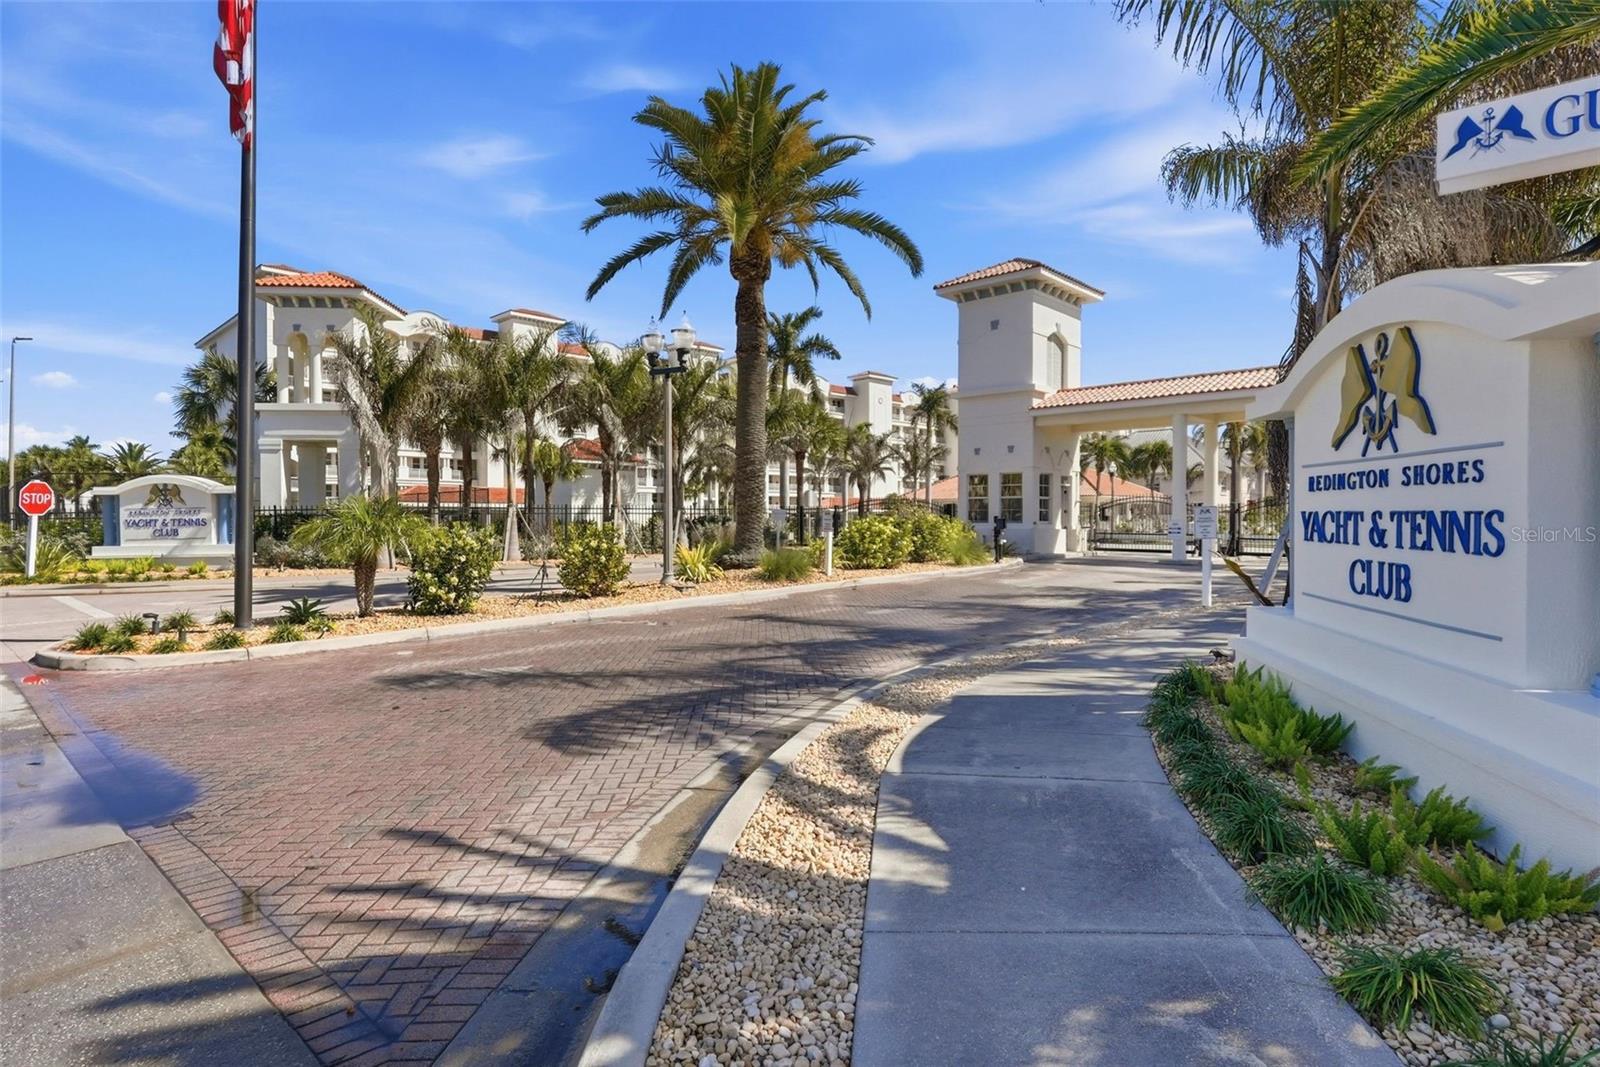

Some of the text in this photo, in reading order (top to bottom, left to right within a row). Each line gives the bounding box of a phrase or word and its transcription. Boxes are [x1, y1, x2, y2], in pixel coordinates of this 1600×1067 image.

[1308, 459, 1485, 492] REDINGTON SHORES
[22, 492, 51, 505] STOP
[125, 518, 207, 528] YACHT & TENNIS
[152, 528, 180, 537] CLUB
[1301, 509, 1506, 558] YACHT & TENNIS
[1349, 559, 1412, 603] CLUB
